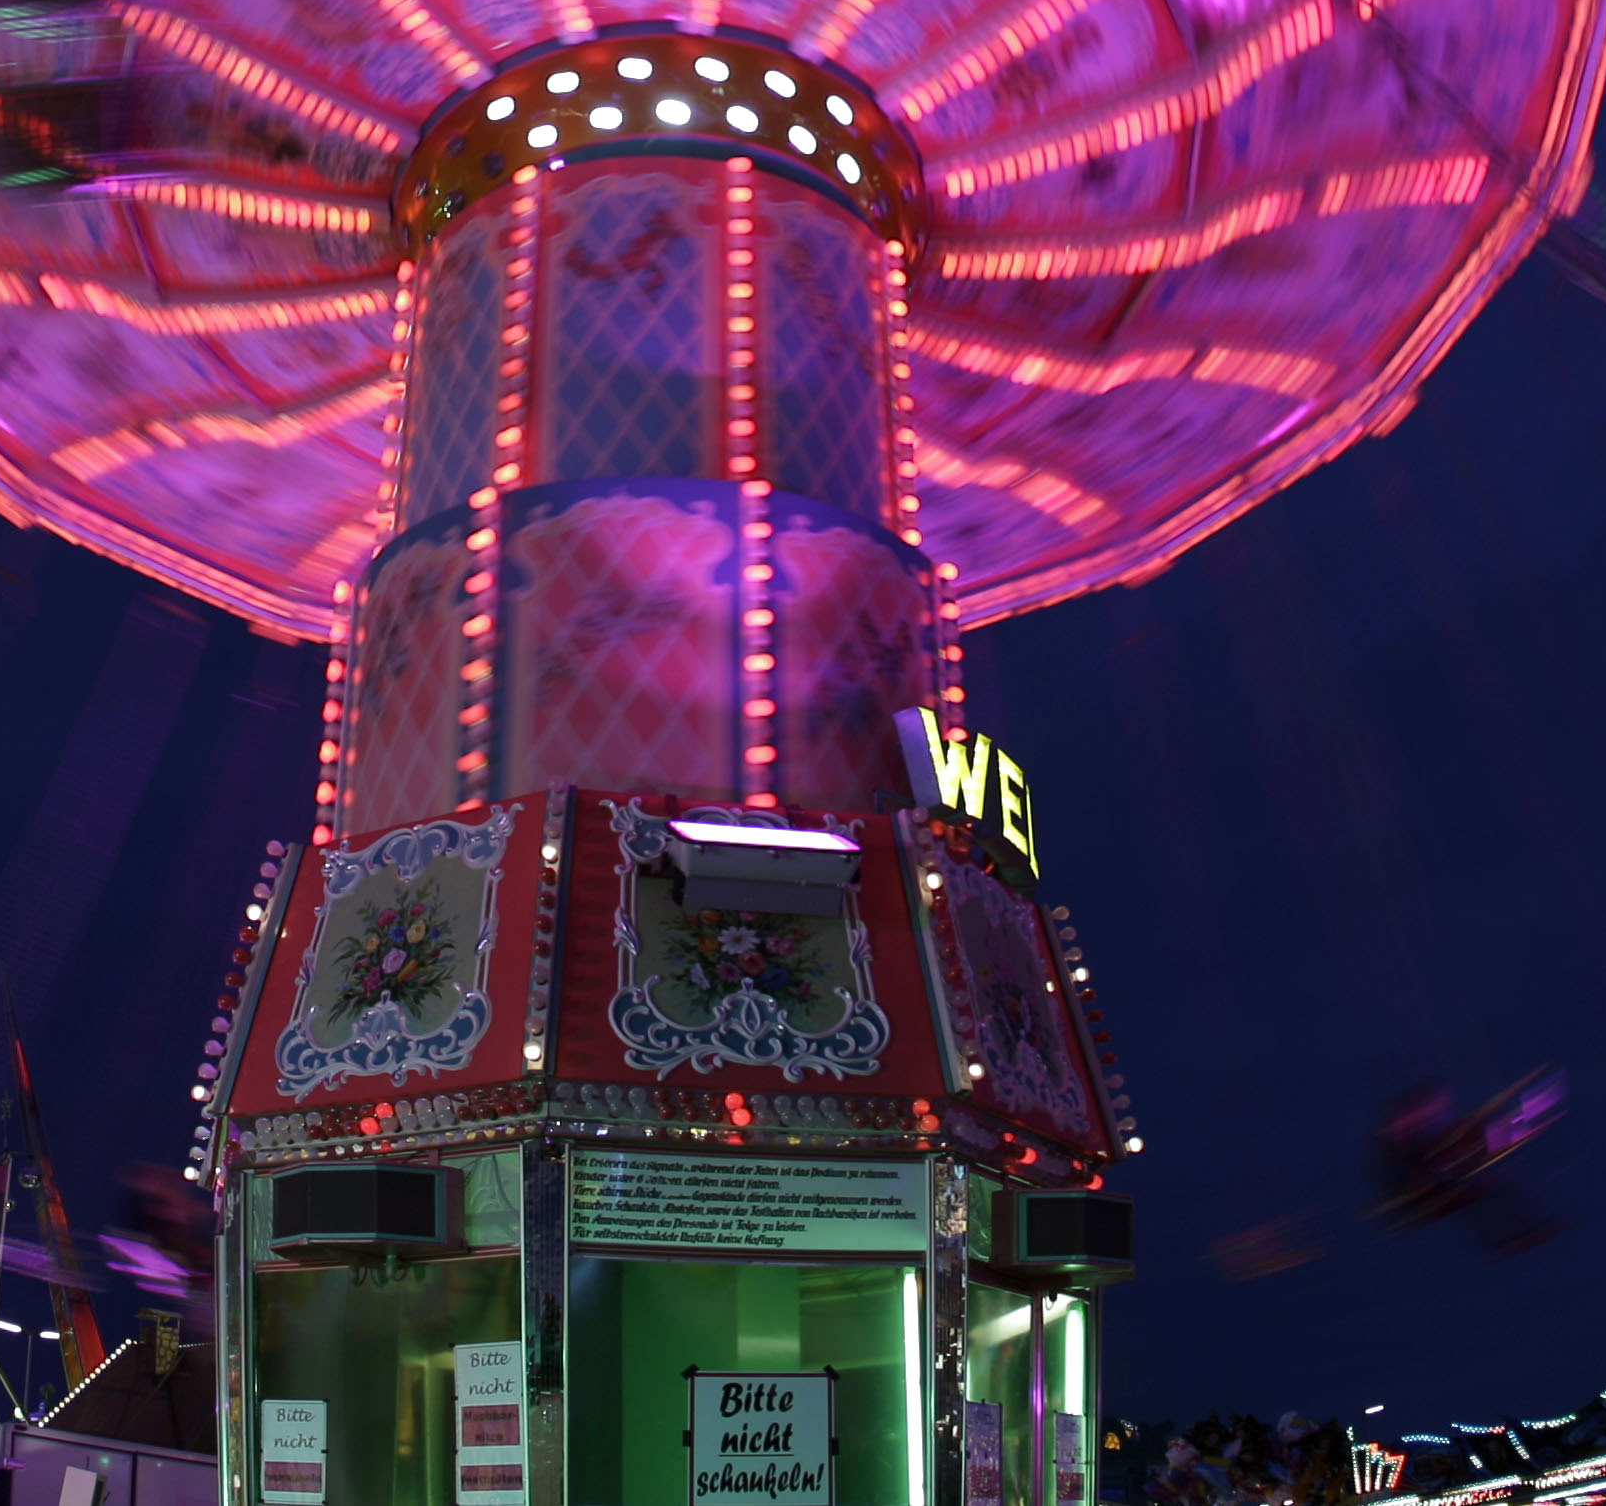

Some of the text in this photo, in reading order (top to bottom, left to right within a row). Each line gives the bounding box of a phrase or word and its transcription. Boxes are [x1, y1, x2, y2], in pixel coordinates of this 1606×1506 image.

[720, 1178, 746, 1188] nicht
[778, 1193, 801, 1204] nicht
[469, 1351, 513, 1369] Bitte
[468, 1377, 516, 1396] nicht
[720, 1381, 795, 1418] Bitte
[275, 1406, 316, 1423] Bitte
[273, 1433, 318, 1450] nicht
[719, 1422, 794, 1454] nicht
[696, 1461, 826, 1500] schaukeln!
